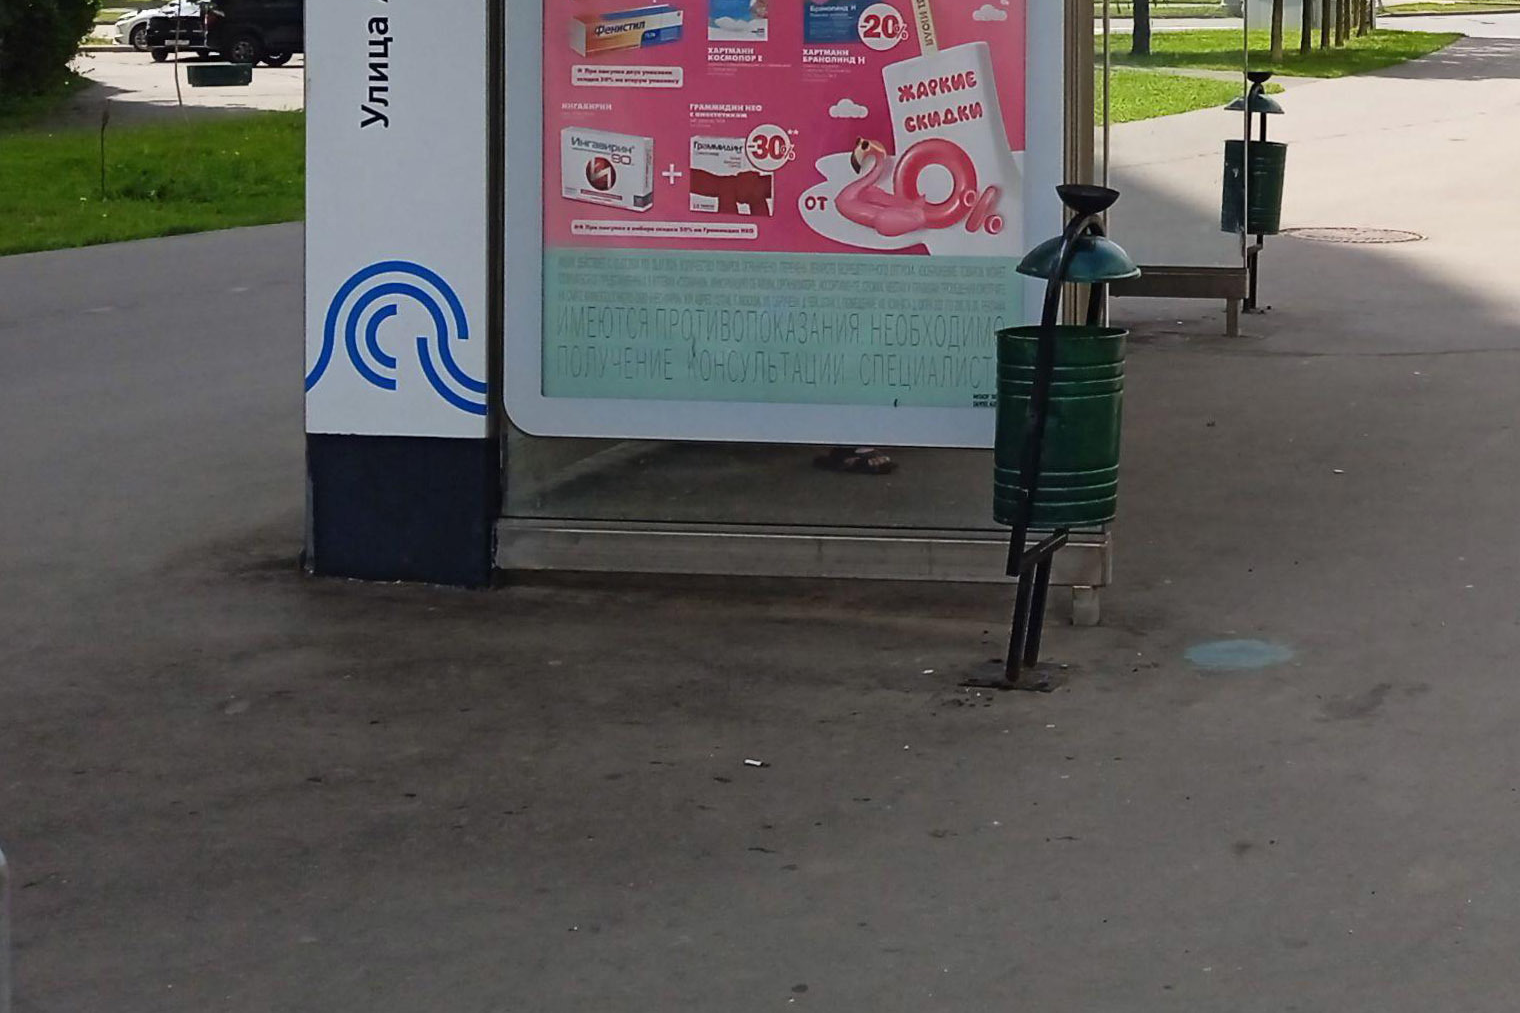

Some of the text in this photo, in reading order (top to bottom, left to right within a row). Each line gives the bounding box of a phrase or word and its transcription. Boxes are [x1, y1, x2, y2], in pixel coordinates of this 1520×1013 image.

[595, 21, 645, 36] Фенистил
[860, 15, 909, 40] -20%
[361, 16, 394, 128] Улица
[802, 56, 856, 64] БРАНОЛИНД
[898, 71, 977, 103] ЖАРКИЕ
[904, 102, 983, 133] СКИДКИ
[571, 137, 632, 154] Ингавирин
[805, 196, 828, 211] ОТ
[557, 306, 648, 338] ИМЕЮТСЯ
[557, 345, 996, 391] ПОЛУЧЕНИЕ КОНСУЛЬТАЦИИ СПЕЦИАЛИСТ
